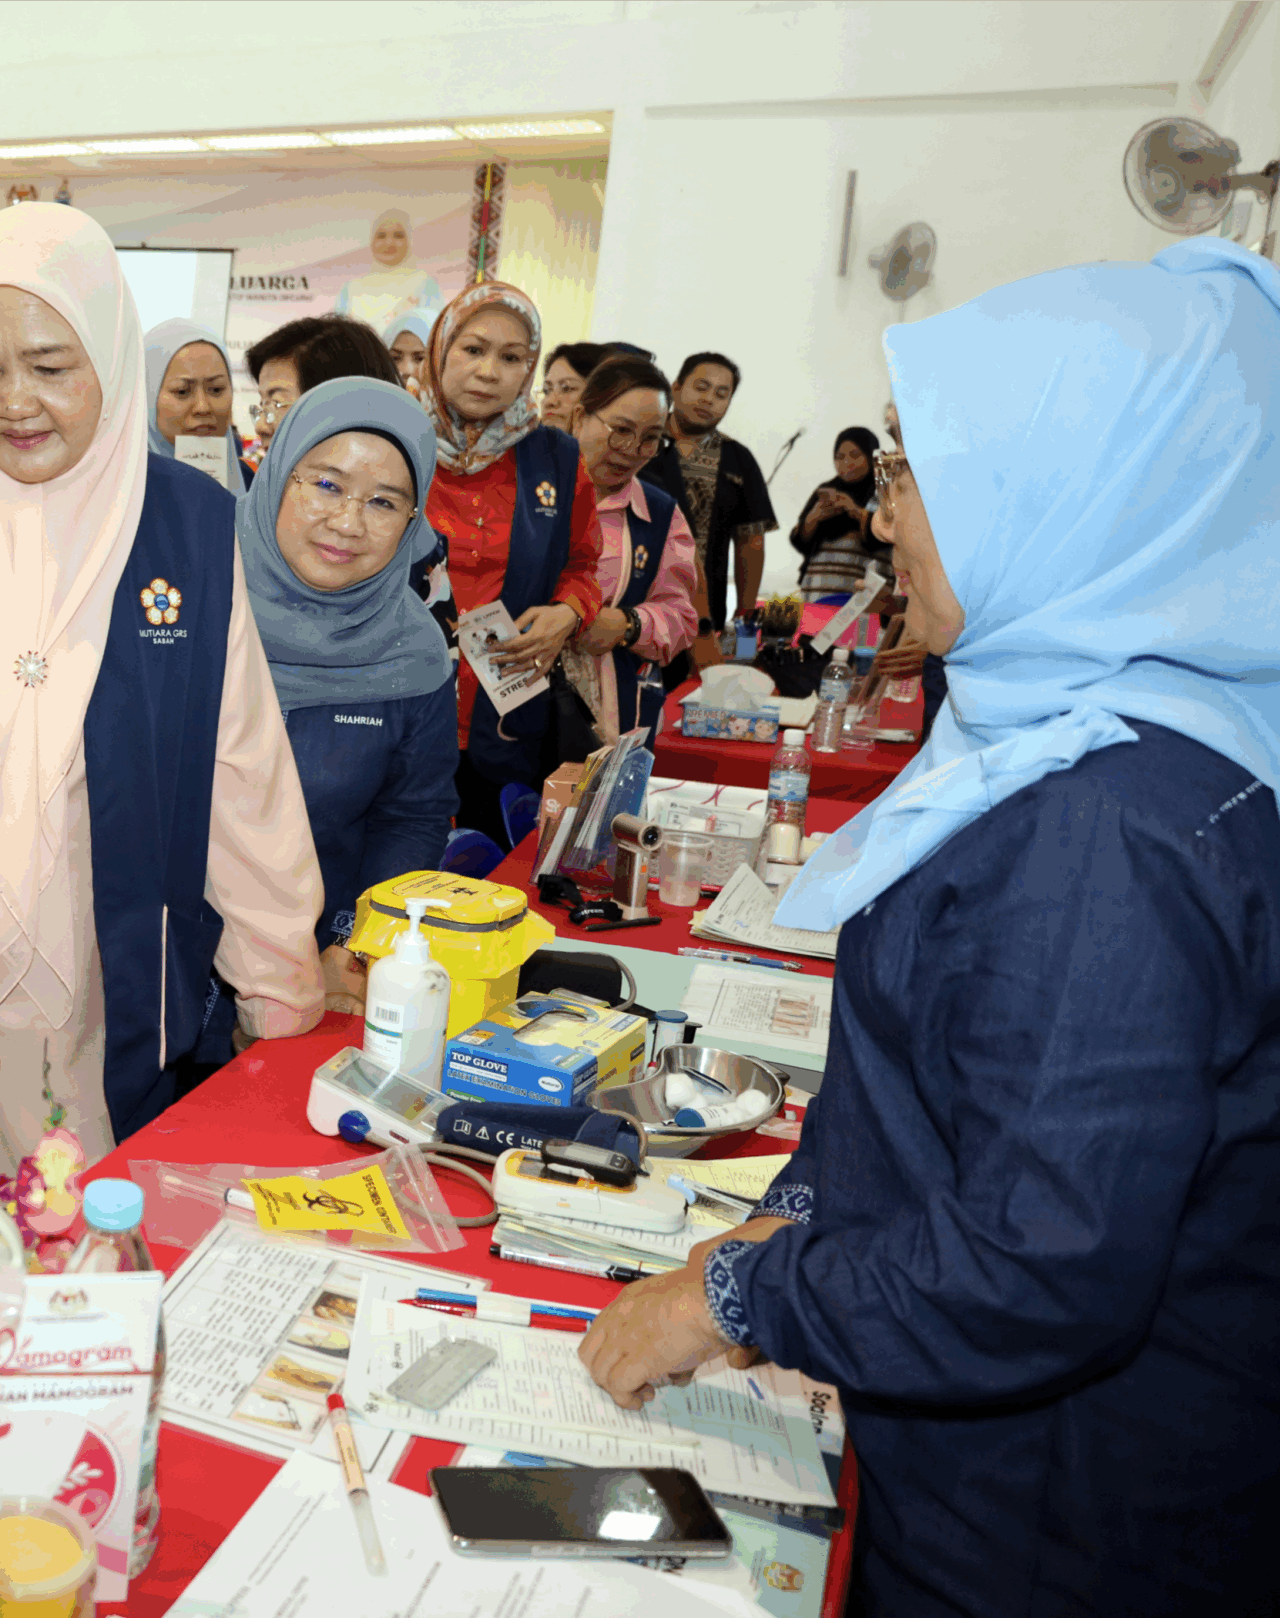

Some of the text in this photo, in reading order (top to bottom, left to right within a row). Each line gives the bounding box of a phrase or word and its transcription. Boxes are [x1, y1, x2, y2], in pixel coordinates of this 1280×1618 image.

[172, 629, 187, 638] GRS
[152, 637, 174, 645] SABAH
[333, 714, 383, 727] SHAHRIAH
[451, 1051, 472, 1064] TOP
[473, 1058, 508, 1074] GLOVE
[528, 1090, 562, 1107] GLOVES
[521, 1136, 543, 1149] LATE
